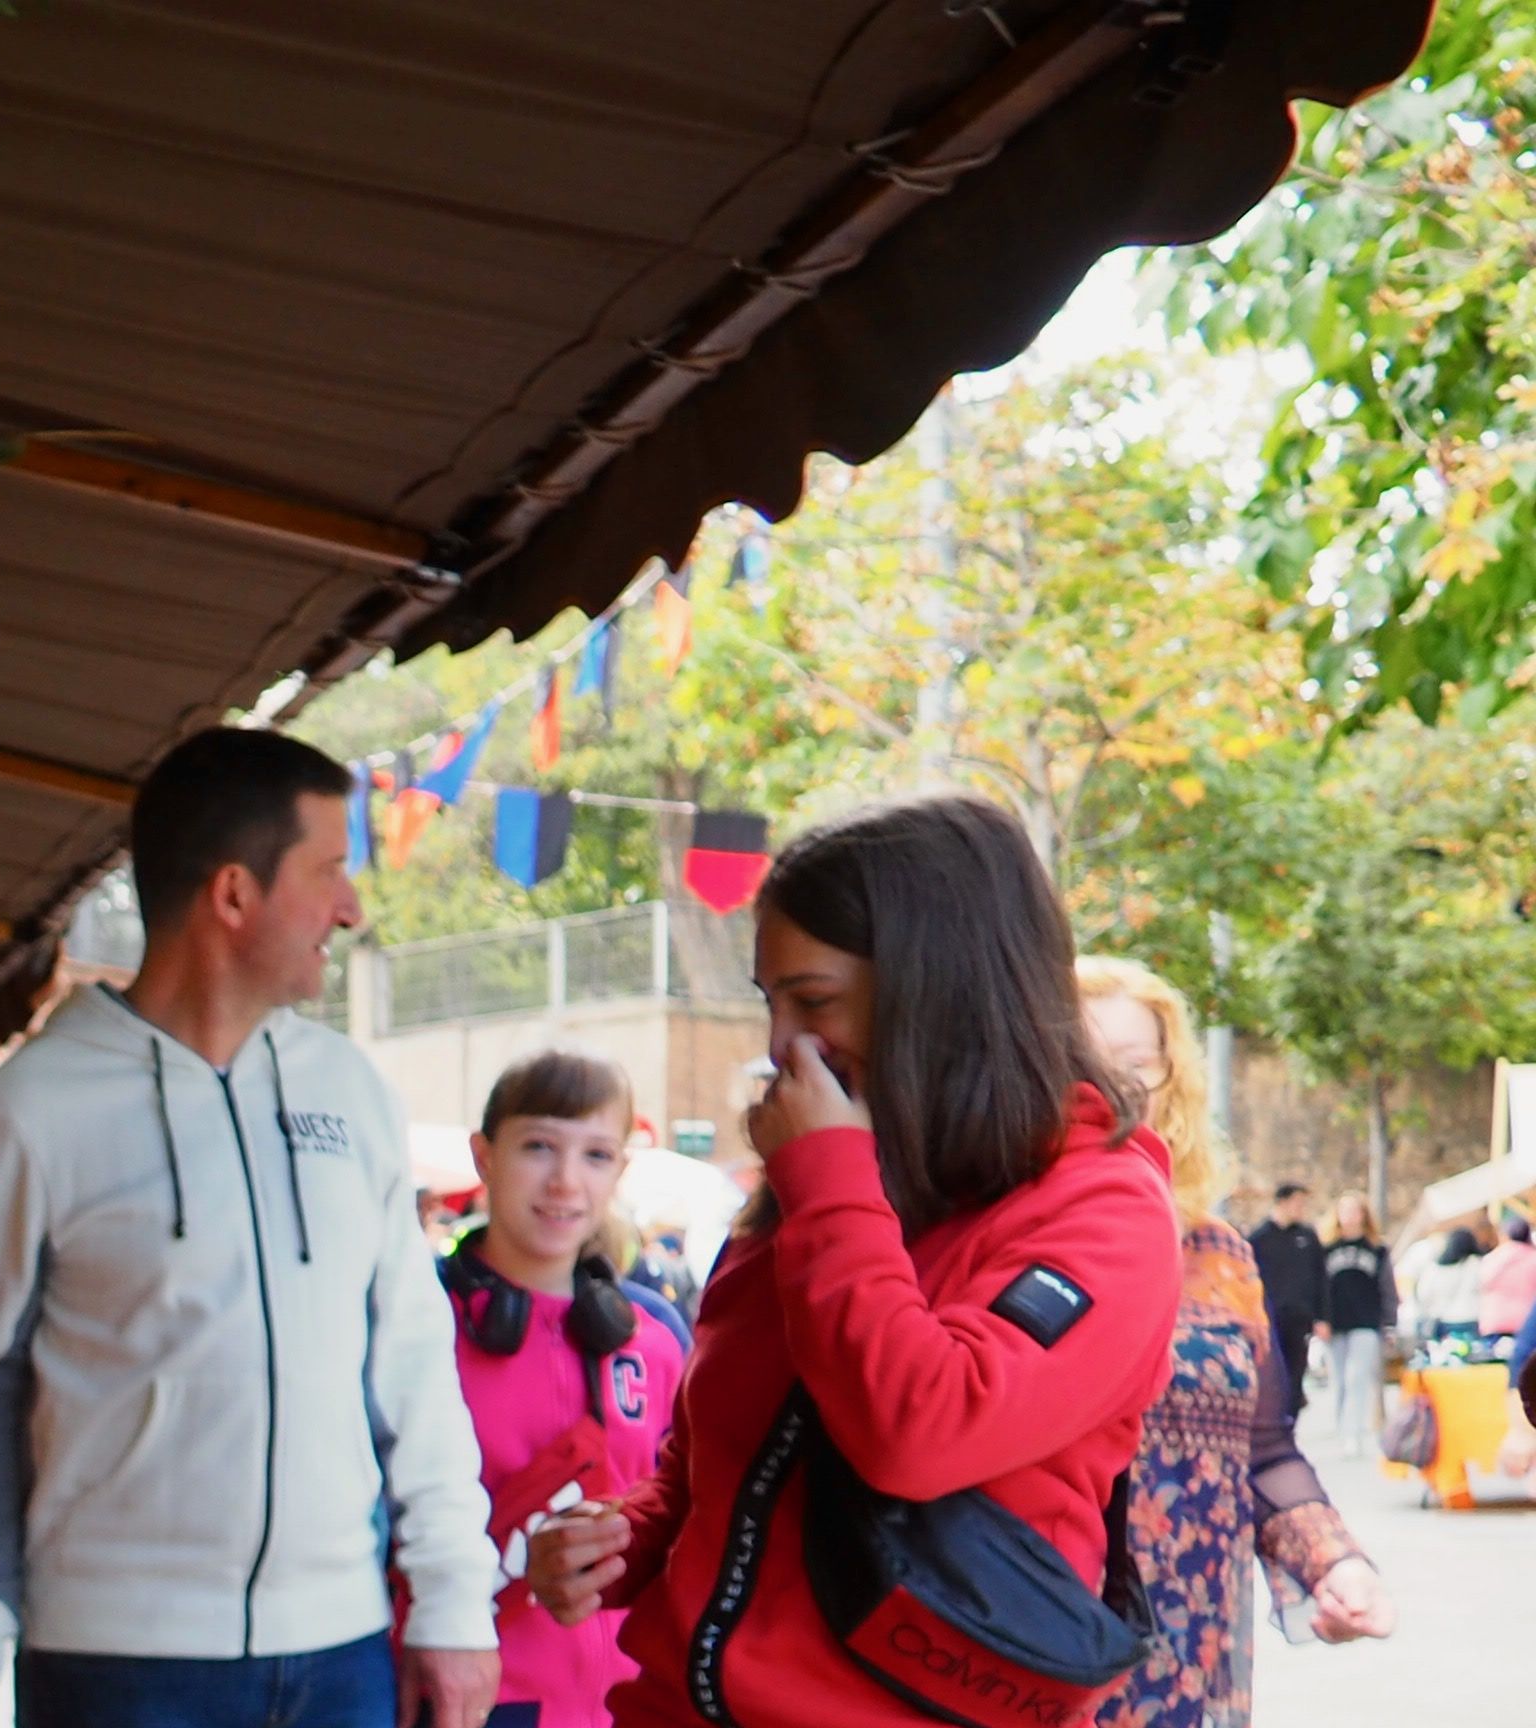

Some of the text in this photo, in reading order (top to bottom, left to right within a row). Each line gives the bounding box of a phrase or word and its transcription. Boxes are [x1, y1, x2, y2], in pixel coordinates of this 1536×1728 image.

[278, 1110, 349, 1147] UESS
[751, 1413, 803, 1496] REPLAY
[720, 1514, 757, 1612] REPLAY
[696, 1623, 721, 1717] REPLAY
